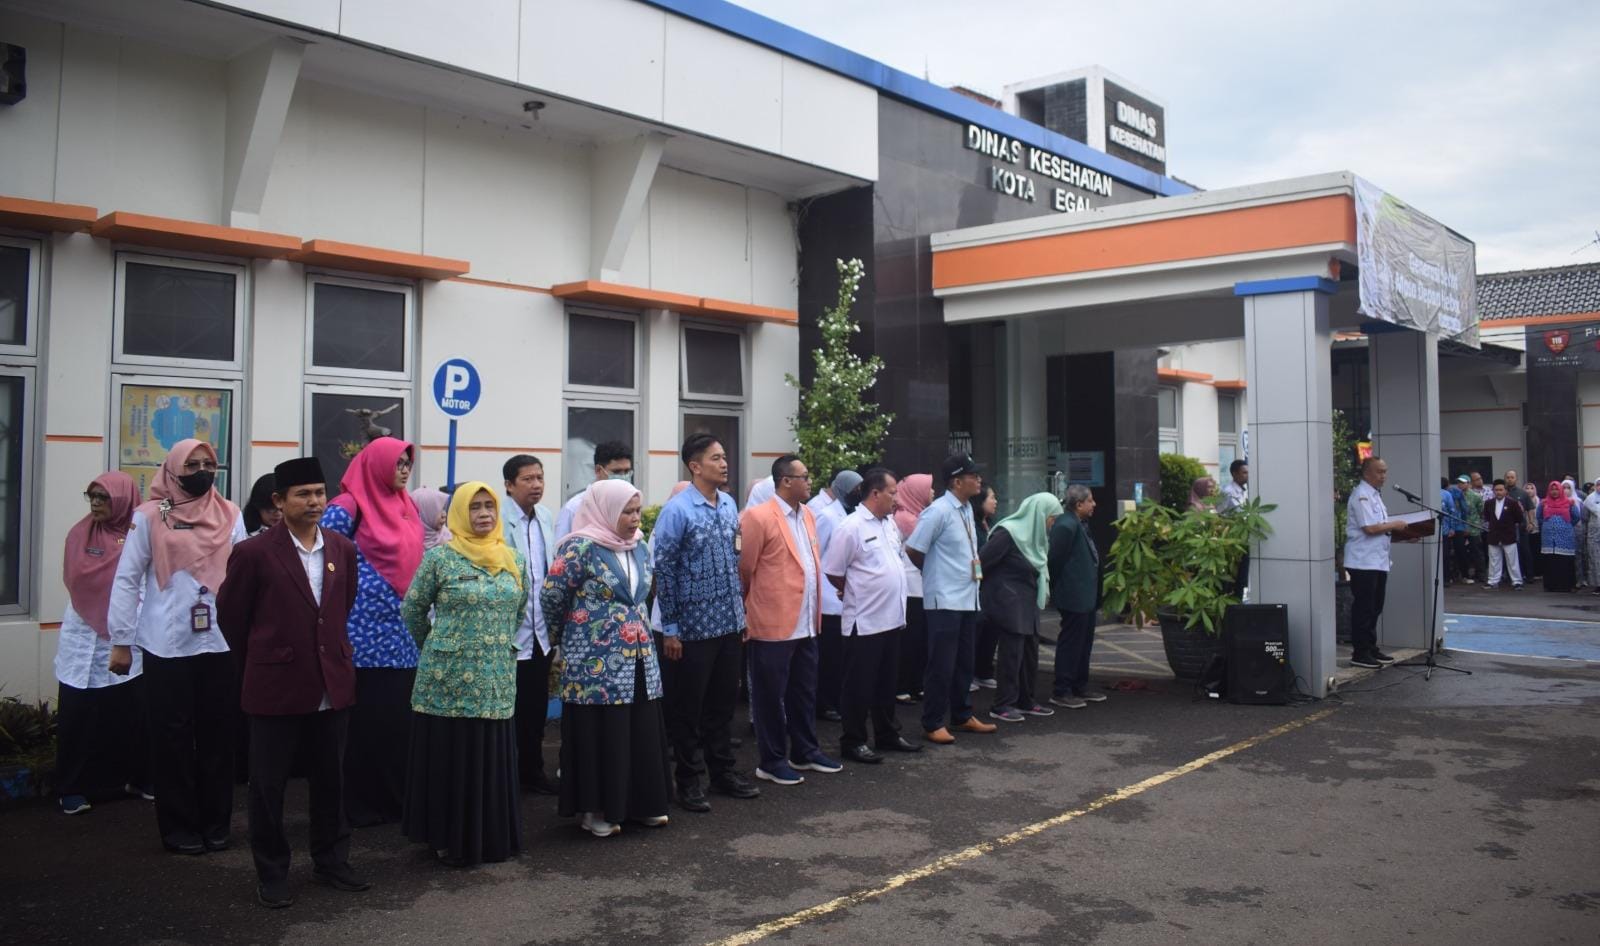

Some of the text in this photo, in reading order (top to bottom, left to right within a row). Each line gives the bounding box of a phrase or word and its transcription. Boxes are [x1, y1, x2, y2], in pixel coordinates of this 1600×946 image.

[1117, 100, 1157, 138] DINAS
[968, 124, 1112, 197] DINAS KESEHATAN
[1109, 124, 1165, 162] KESEHATAN
[992, 165, 1036, 202] KOTA
[444, 364, 470, 398] P
[441, 397, 471, 410] MOTOR
